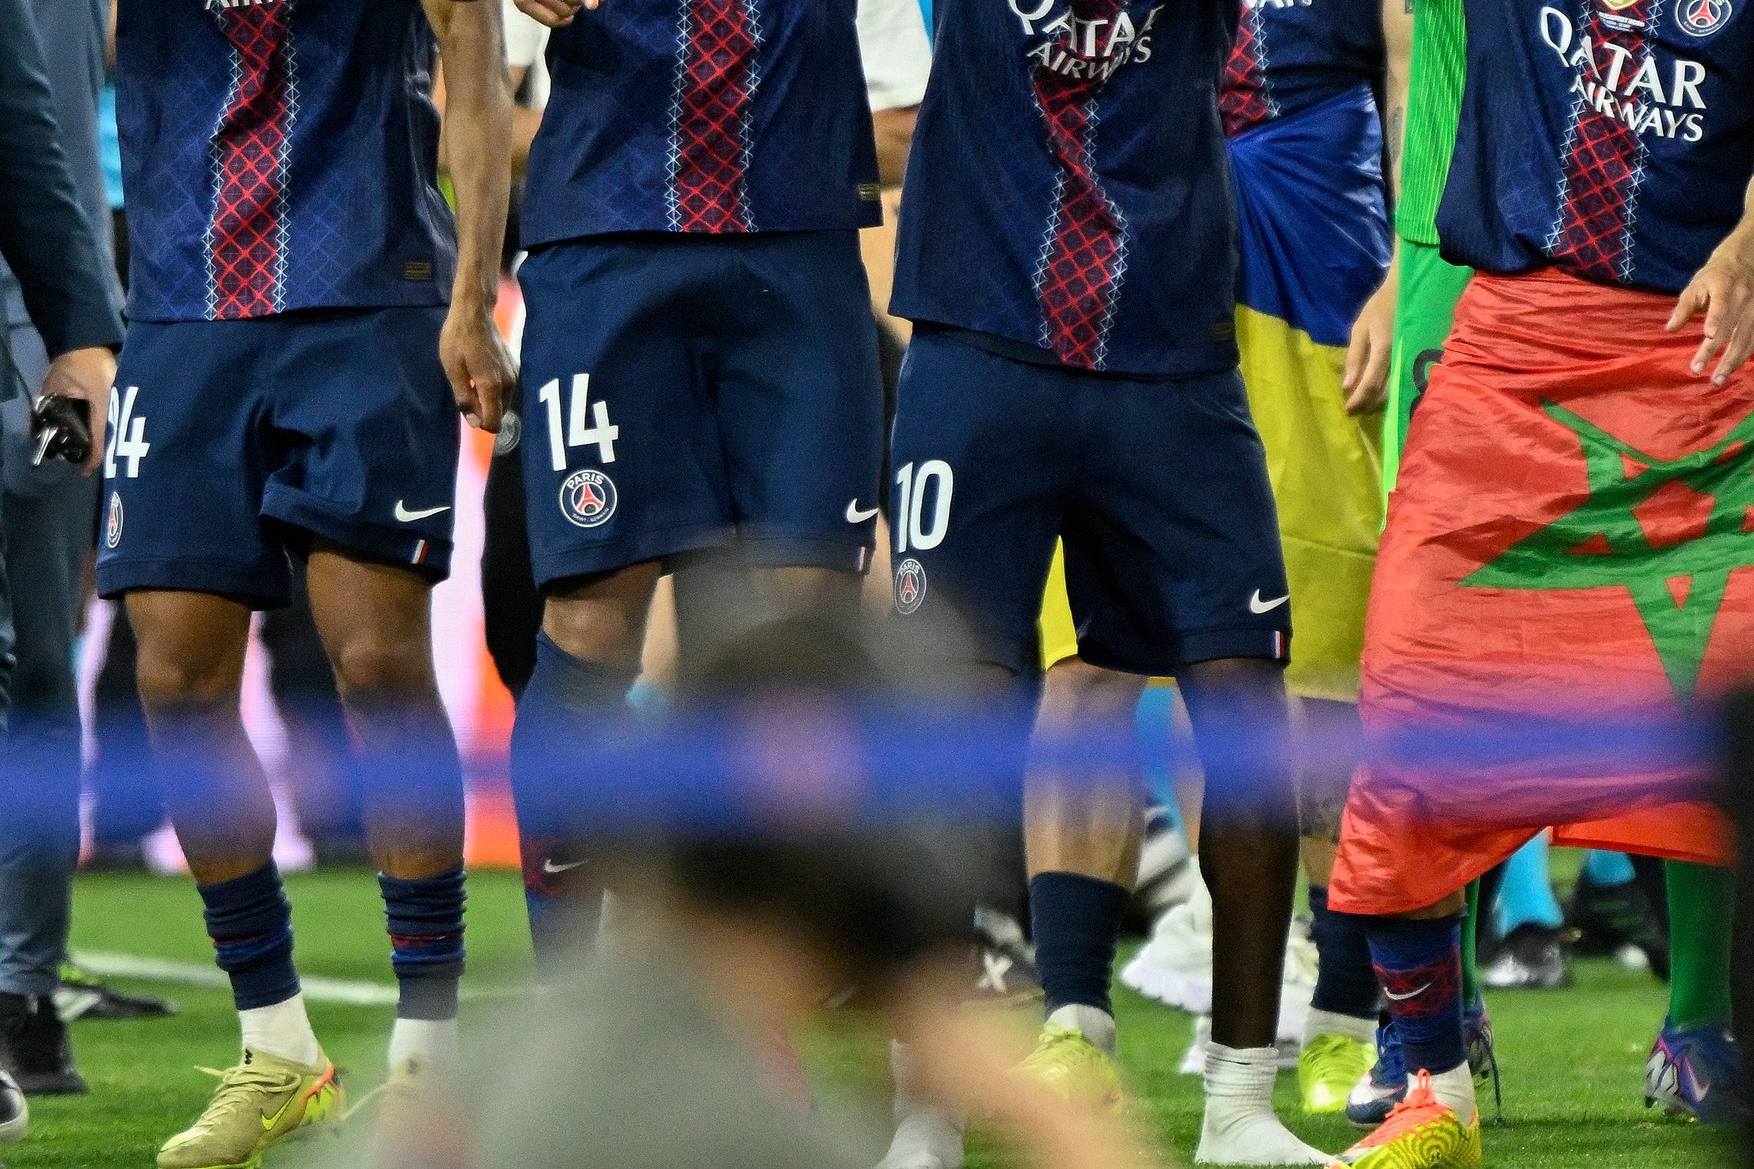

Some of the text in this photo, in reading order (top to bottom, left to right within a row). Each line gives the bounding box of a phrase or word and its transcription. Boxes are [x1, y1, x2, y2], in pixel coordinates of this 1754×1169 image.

[1541, 6, 1707, 110] QATAR
[1570, 74, 1704, 142] AIRWAYS
[105, 386, 150, 479] 24
[539, 372, 619, 472] 14
[566, 472, 605, 490] PARIS
[896, 459, 954, 554] 10
